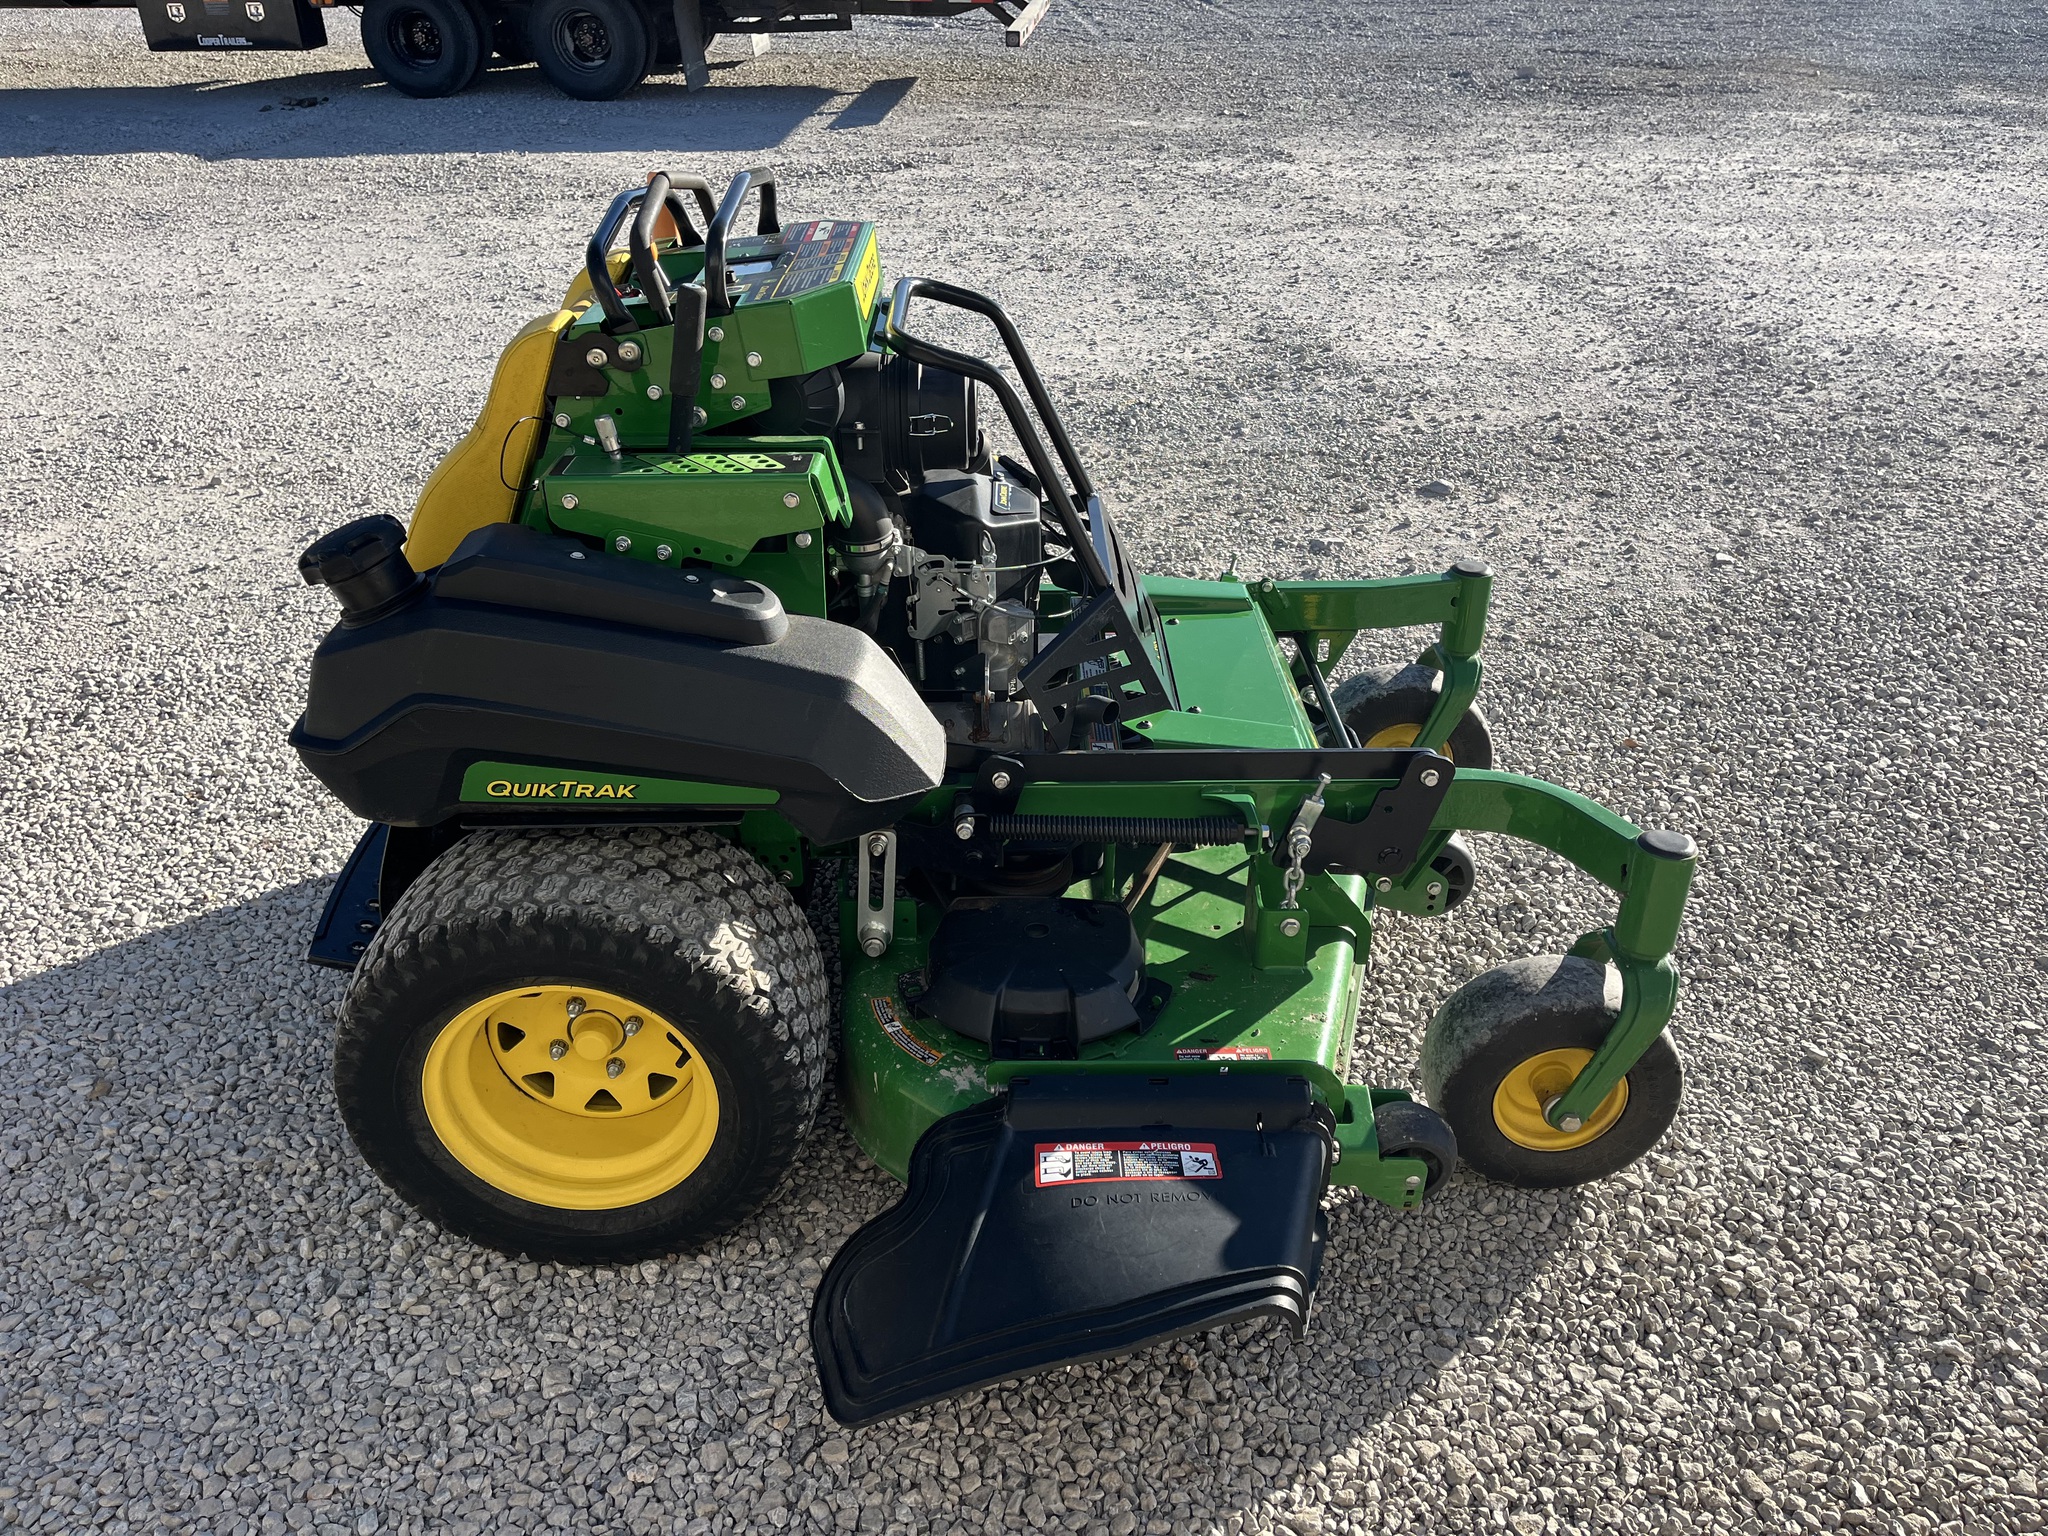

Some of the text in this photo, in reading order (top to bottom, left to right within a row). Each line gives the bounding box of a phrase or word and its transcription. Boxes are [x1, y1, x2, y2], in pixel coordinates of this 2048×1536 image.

[486, 781, 637, 798] QUIKTRAK
[1066, 1143, 1105, 1152] DANGER
[1151, 1142, 1191, 1151] PELIGRO
[1070, 1191, 1222, 1209] DO NOT REMOV
